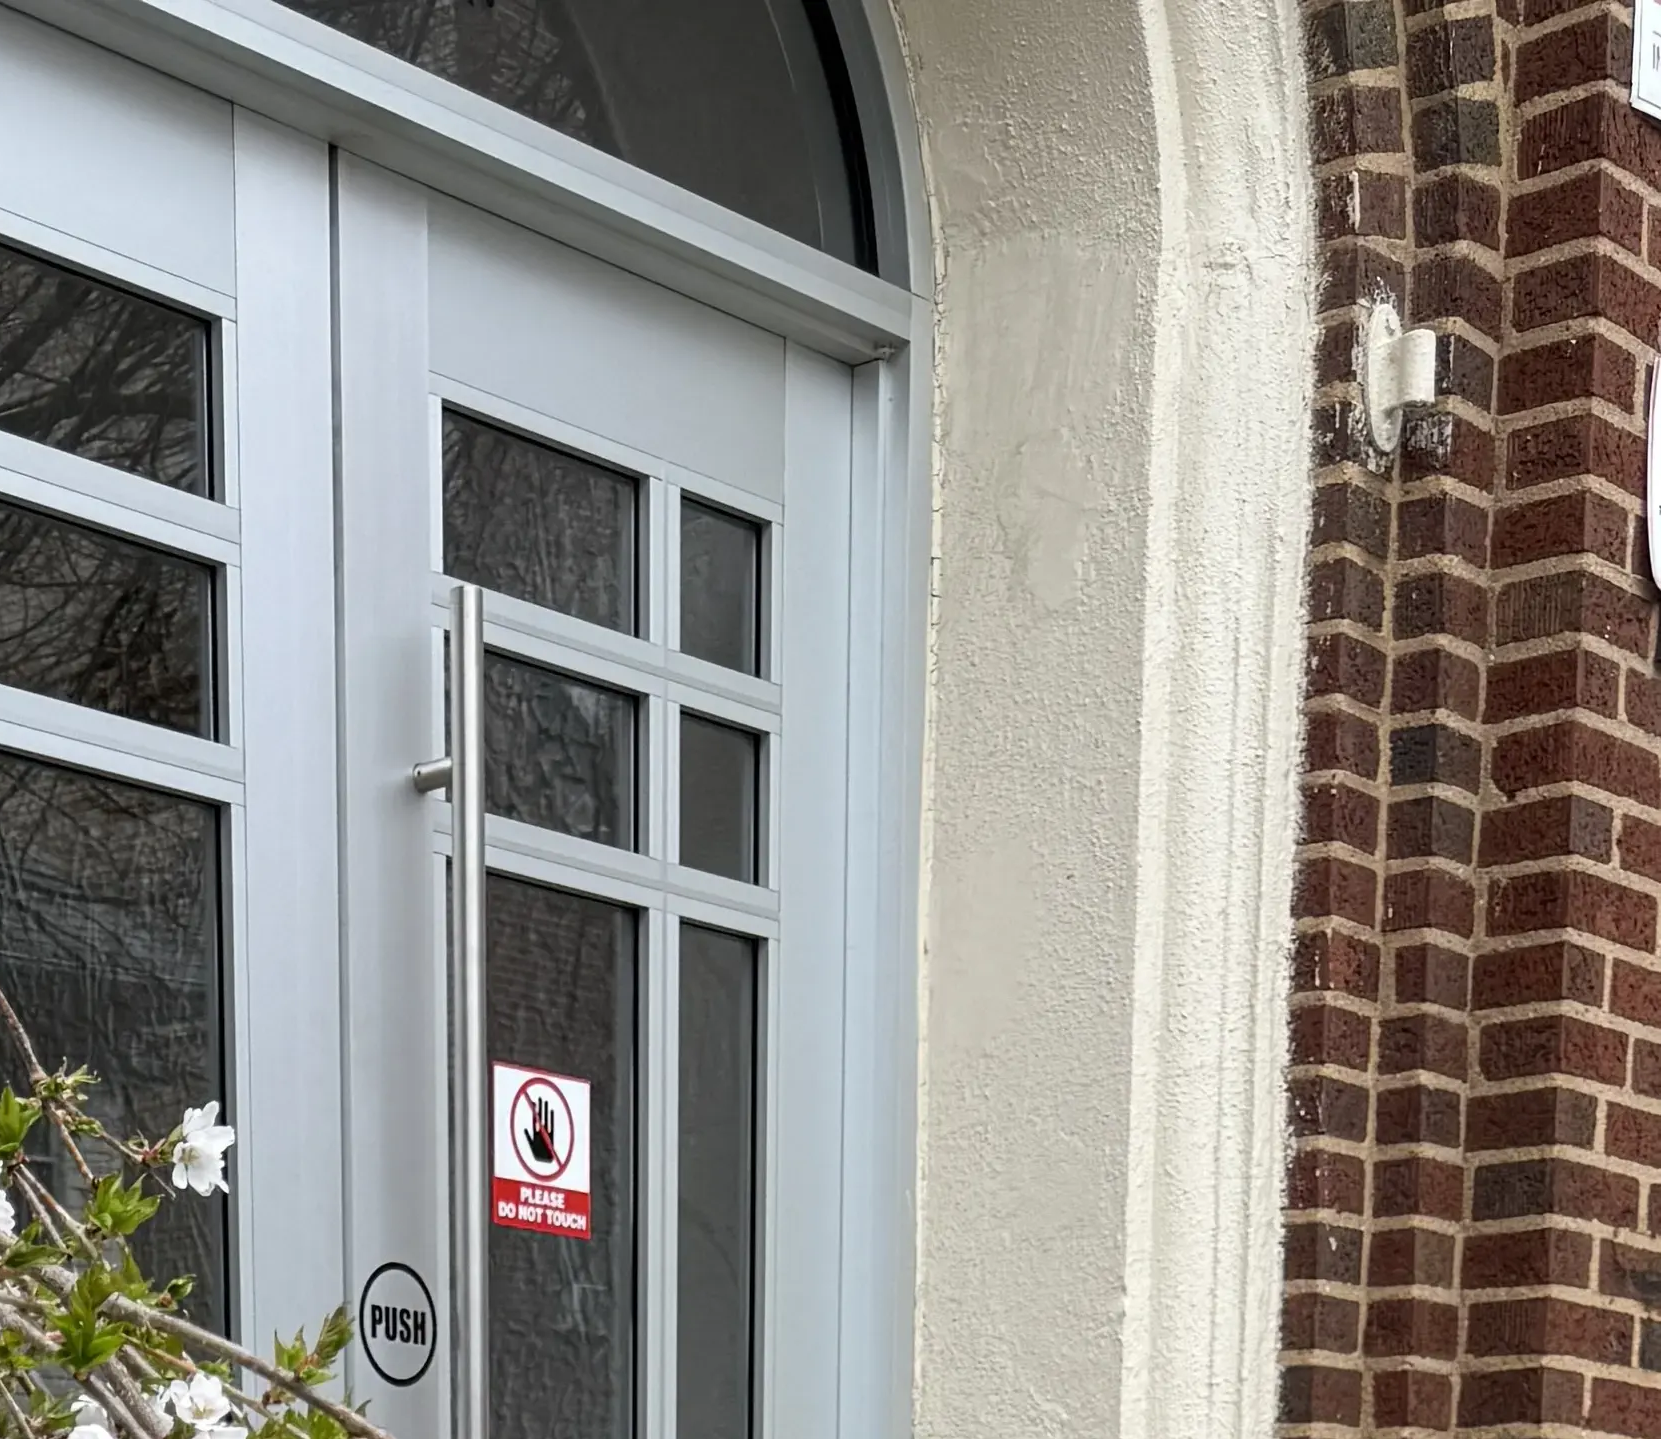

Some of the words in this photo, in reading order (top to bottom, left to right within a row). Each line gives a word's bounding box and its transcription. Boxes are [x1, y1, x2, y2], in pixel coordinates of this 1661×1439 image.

[520, 1187, 565, 1209] PLEASE
[498, 1201, 517, 1219] DO
[518, 1205, 544, 1223] NOT
[546, 1209, 587, 1231] TOUCH
[371, 1304, 426, 1346] PUSH
